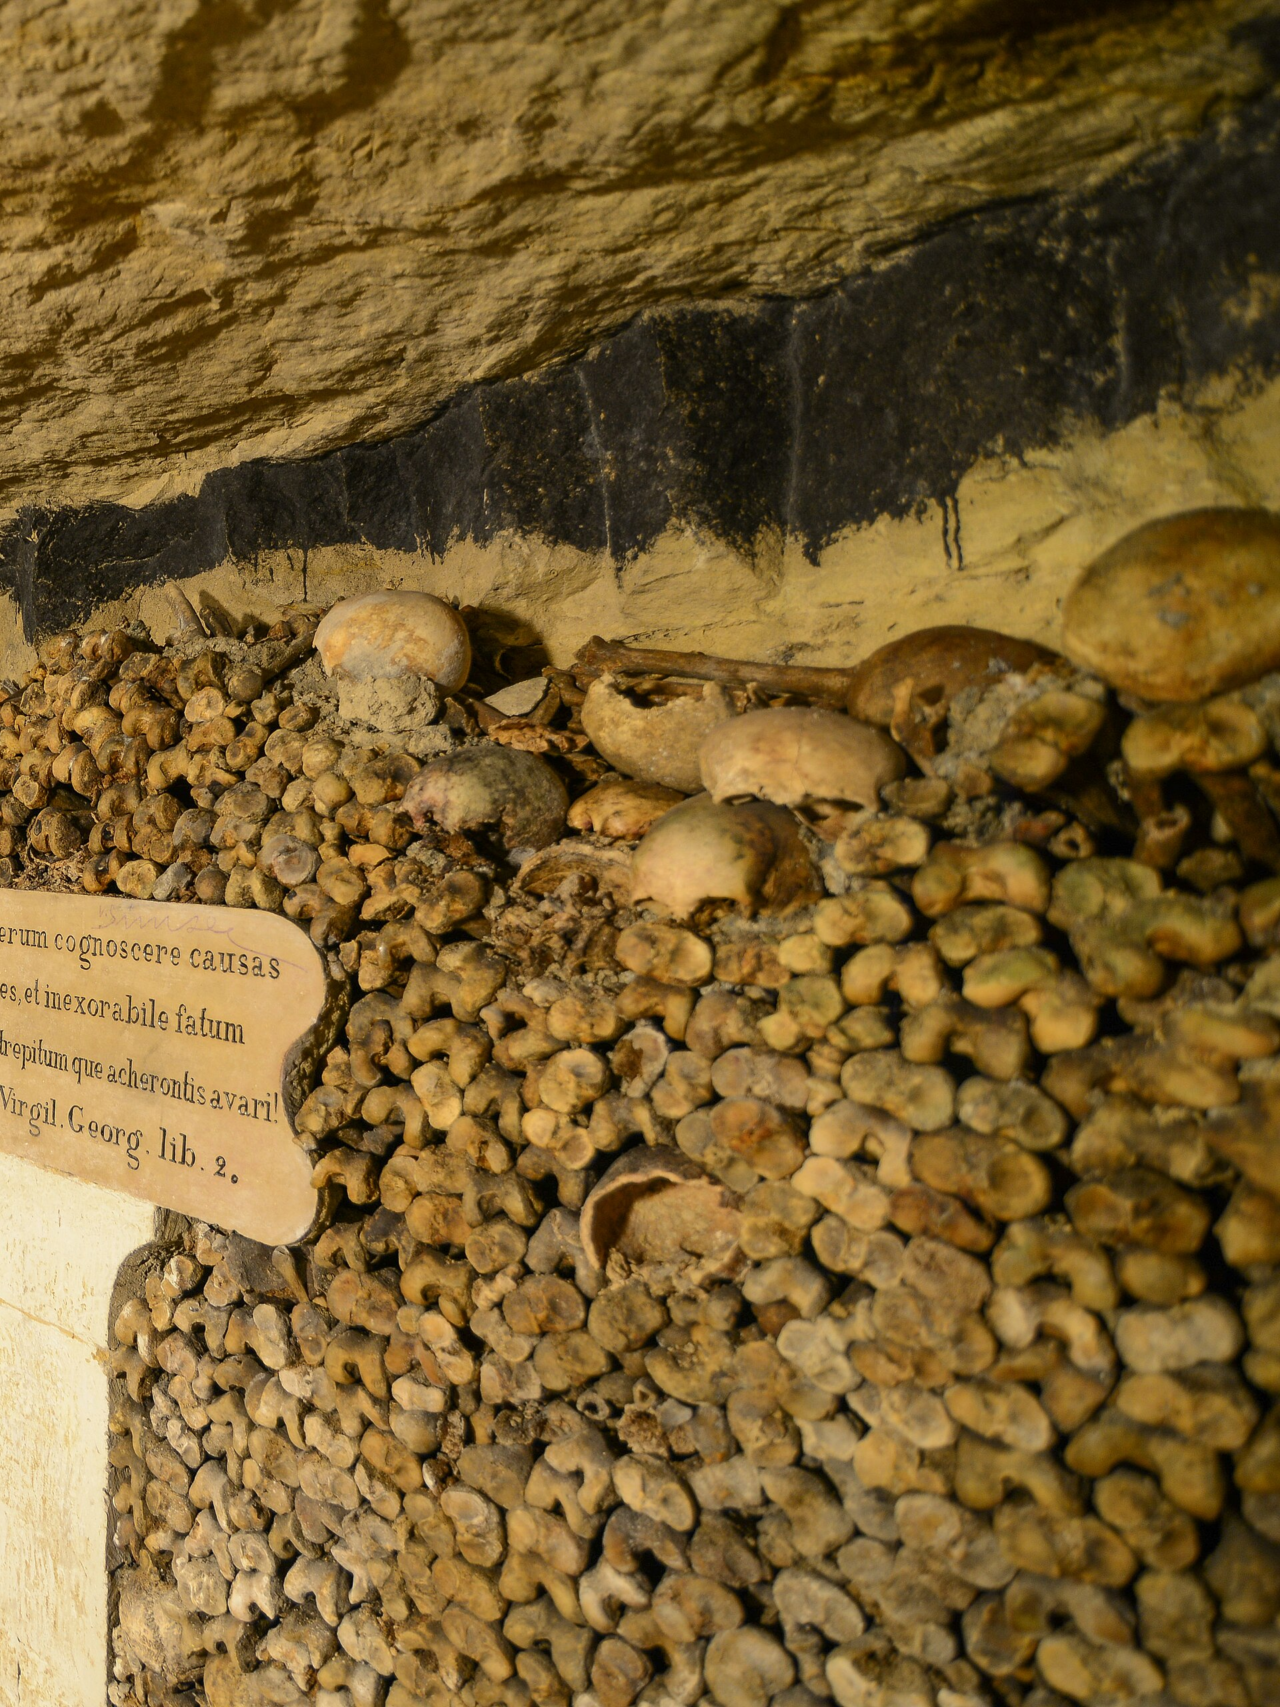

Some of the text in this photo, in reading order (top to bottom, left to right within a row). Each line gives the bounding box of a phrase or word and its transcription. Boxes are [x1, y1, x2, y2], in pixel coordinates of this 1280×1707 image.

[54, 932, 181, 971] cognoscere
[189, 948, 281, 980] causas
[24, 978, 41, 1006] et
[44, 984, 169, 1031] inexorabile
[174, 1003, 246, 1045] fatum
[107, 1058, 207, 1106] acherontis
[210, 1090, 279, 1124] avari!
[213, 1155, 240, 1185] 2.
